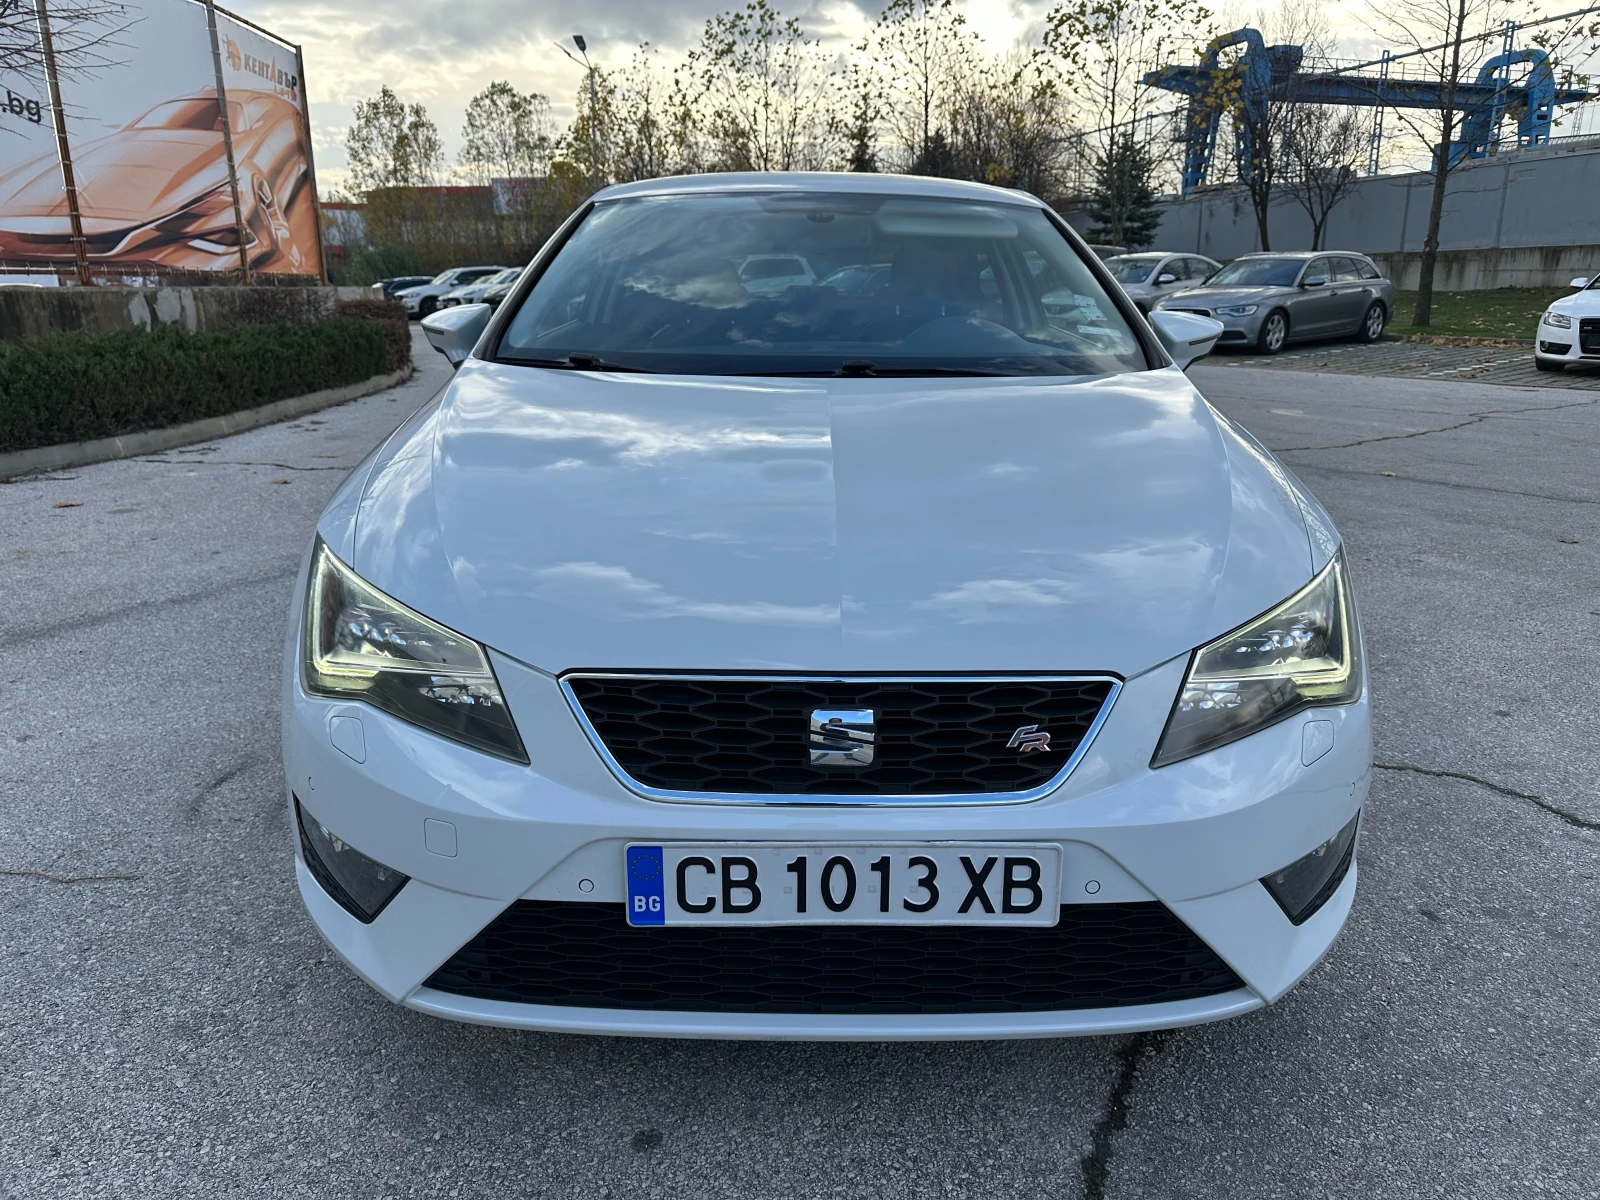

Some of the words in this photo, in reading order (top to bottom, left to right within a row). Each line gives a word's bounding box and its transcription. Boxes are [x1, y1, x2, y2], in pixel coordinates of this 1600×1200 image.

[244, 53, 298, 91] КЕНТАВЪР
[1005, 724, 1052, 752] FR
[675, 856, 762, 914] CB
[786, 855, 940, 913] 1013
[957, 856, 1043, 914] XB
[634, 895, 661, 912] BG
